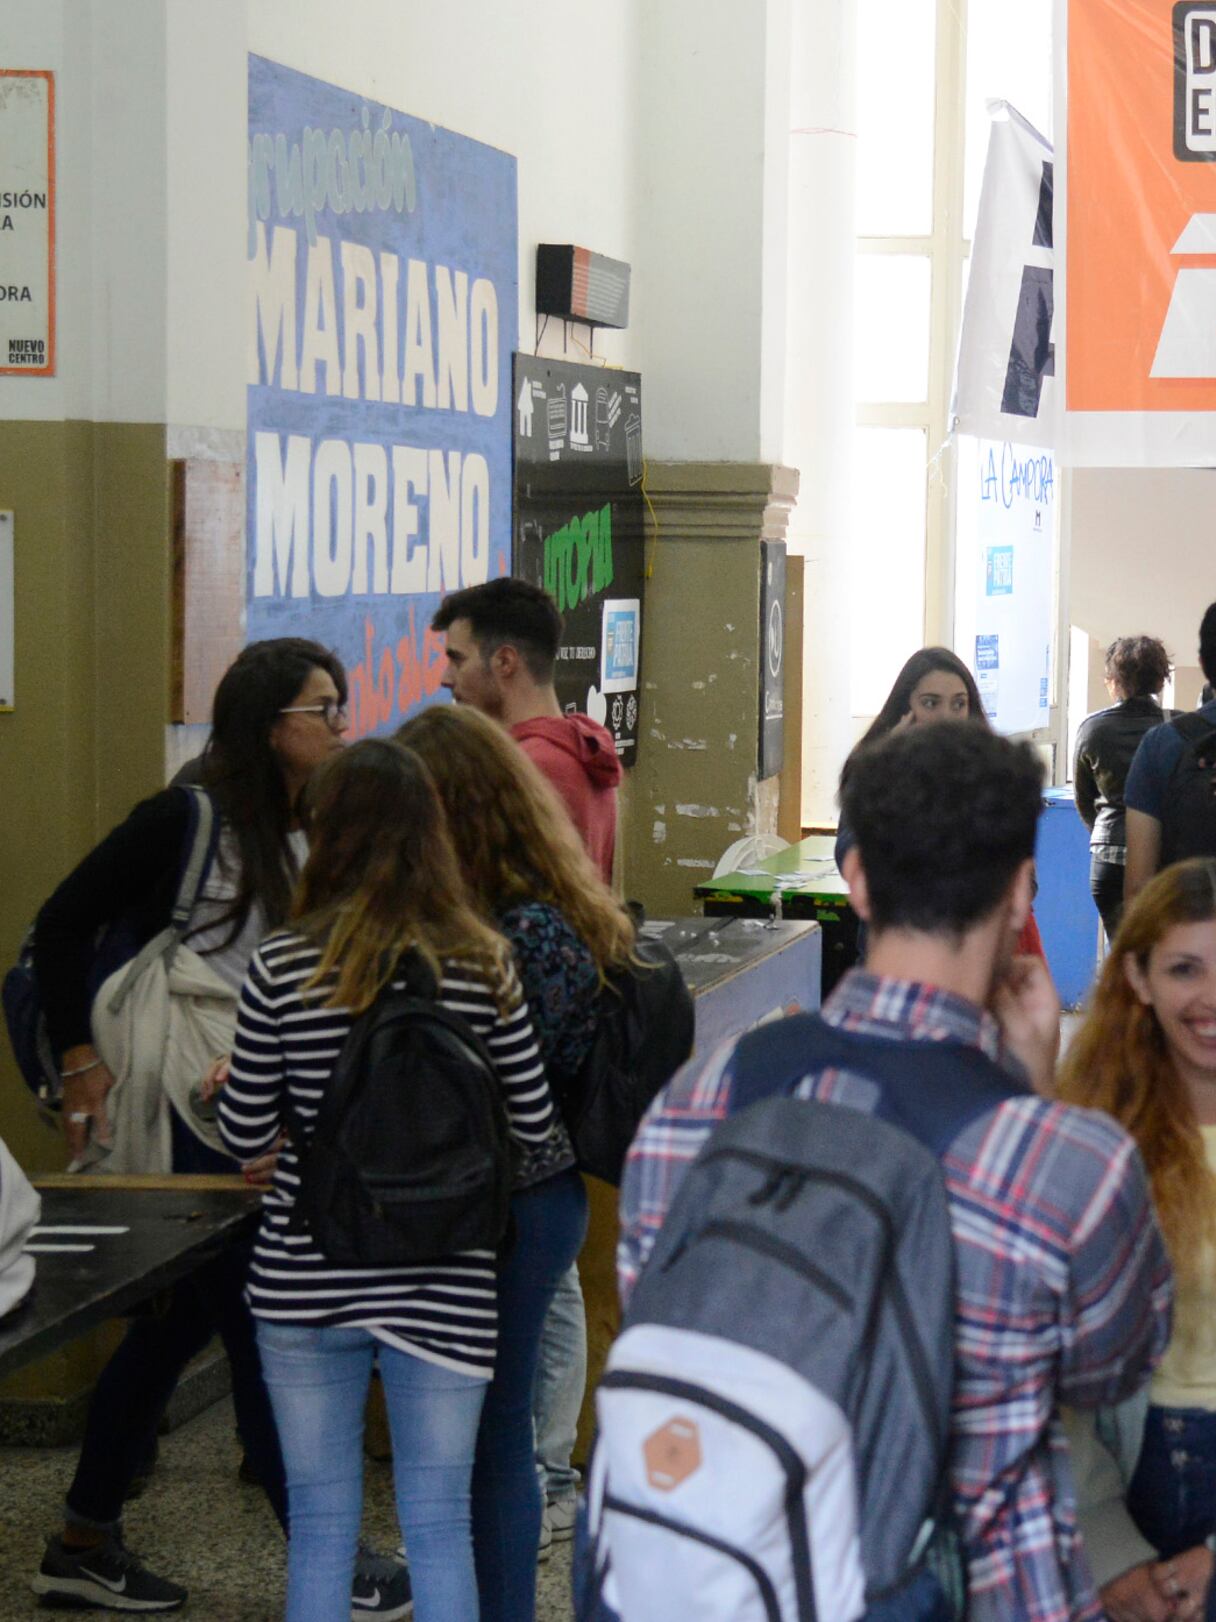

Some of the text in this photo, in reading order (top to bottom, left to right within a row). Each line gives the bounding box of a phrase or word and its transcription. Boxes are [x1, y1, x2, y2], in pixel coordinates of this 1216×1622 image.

[0, 190, 46, 209] SIÓN
[247, 220, 498, 417] MARIANO
[9, 340, 45, 353] NUEVO
[9, 353, 45, 364] CENTRO
[980, 447, 998, 503] LA
[253, 431, 490, 598] MORENO
